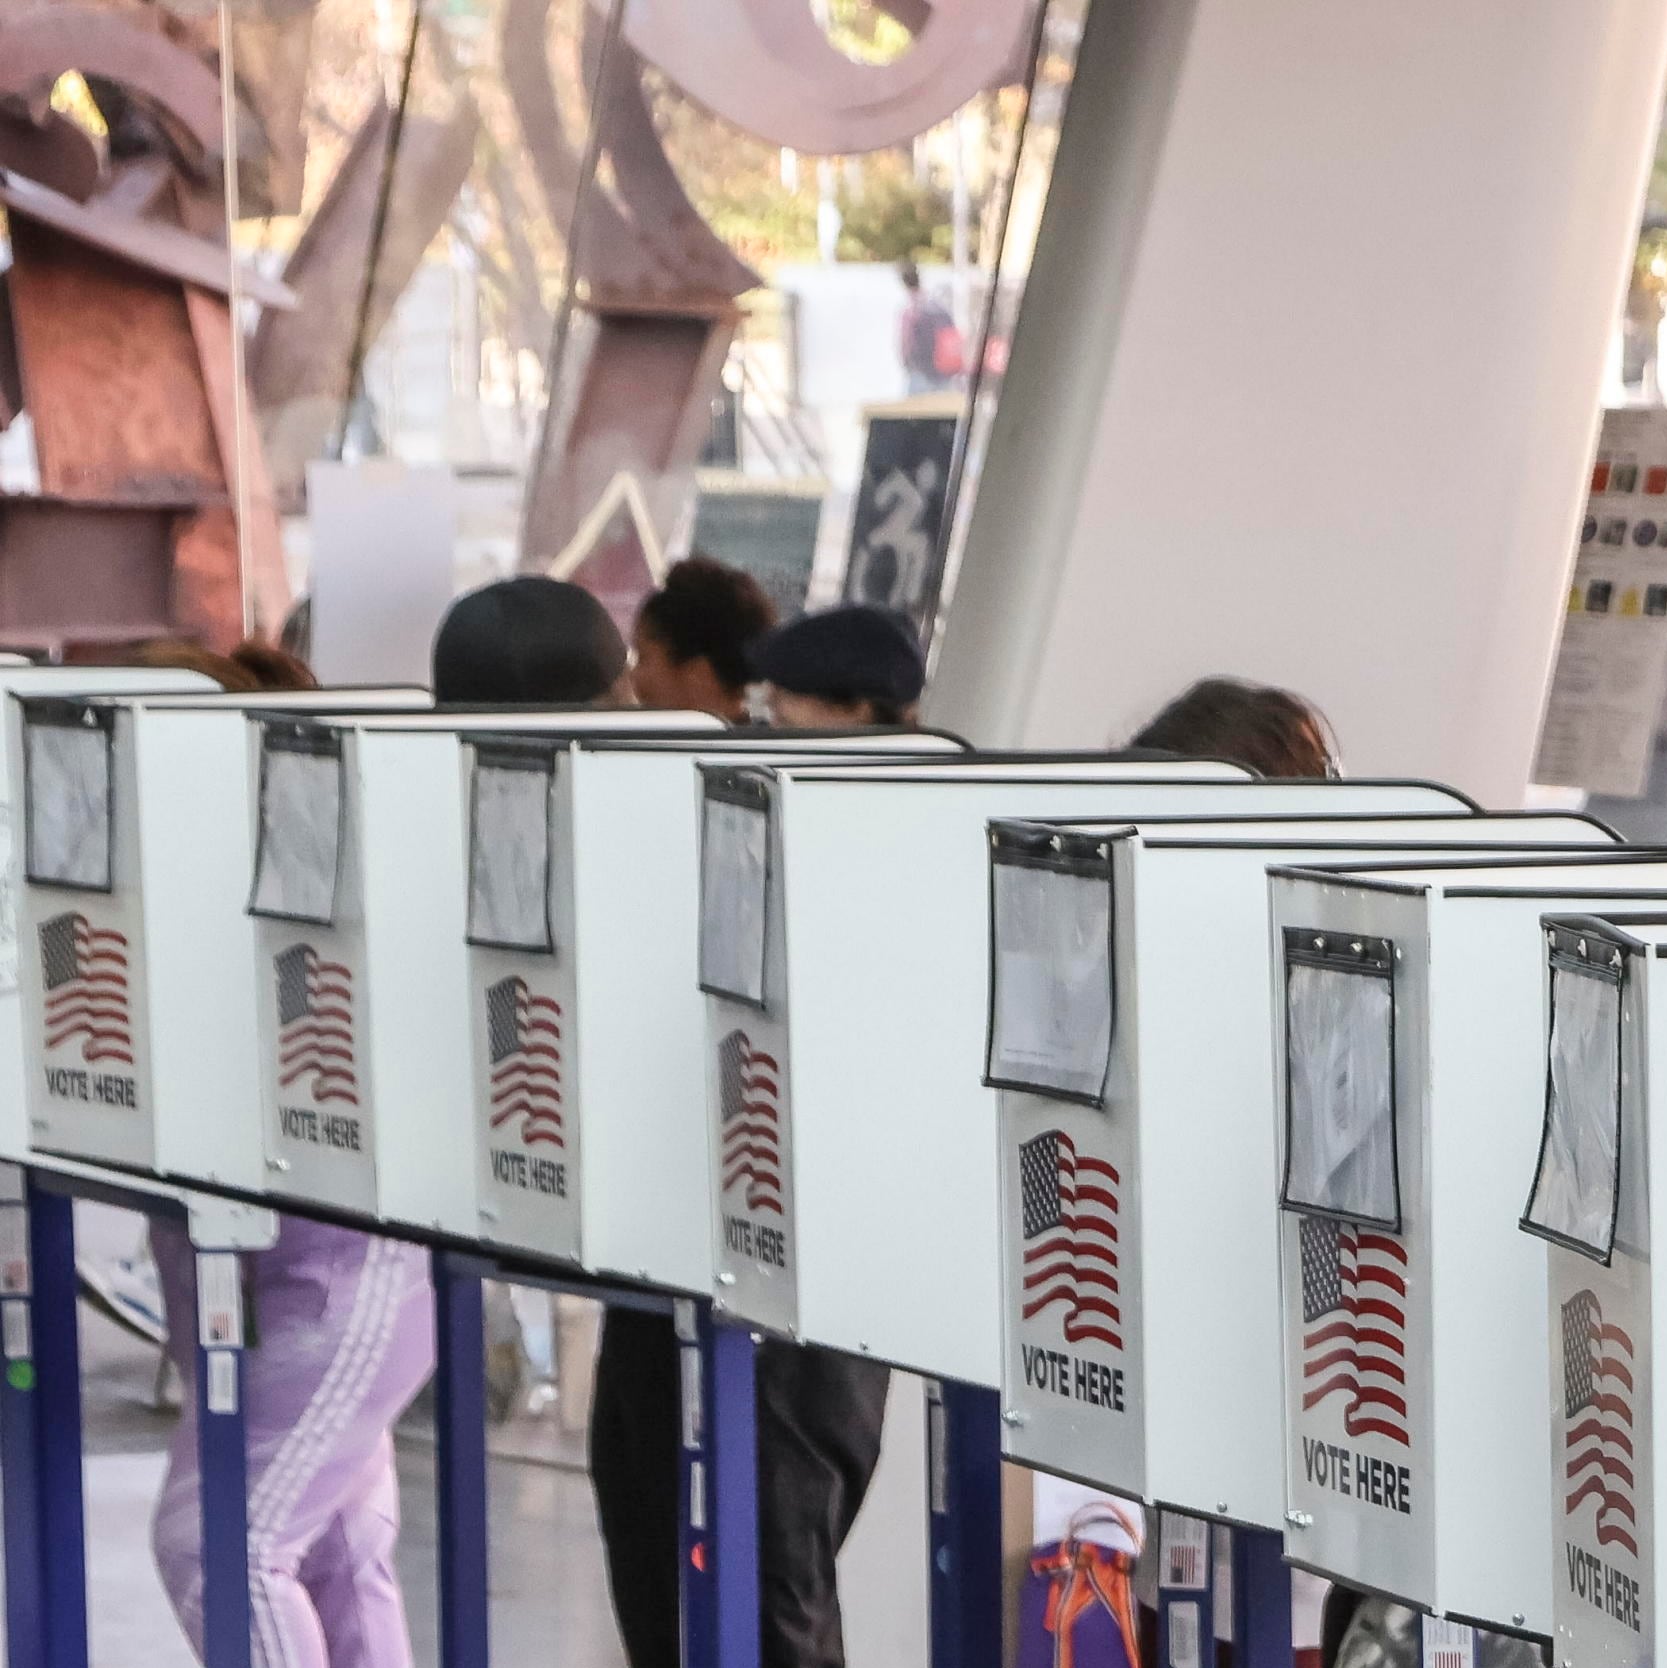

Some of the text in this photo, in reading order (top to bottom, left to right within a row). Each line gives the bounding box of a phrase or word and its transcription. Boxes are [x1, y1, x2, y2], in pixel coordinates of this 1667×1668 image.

[45, 1067, 136, 1108] VOTE HERE
[279, 1106, 361, 1151] VOTE HERE
[490, 1148, 565, 1198] VOTE HERE
[1022, 1344, 1124, 1412] VOTE HERE
[1303, 1436, 1410, 1514] VOTE HERE
[1566, 1542, 1640, 1633] VOTE HERE
